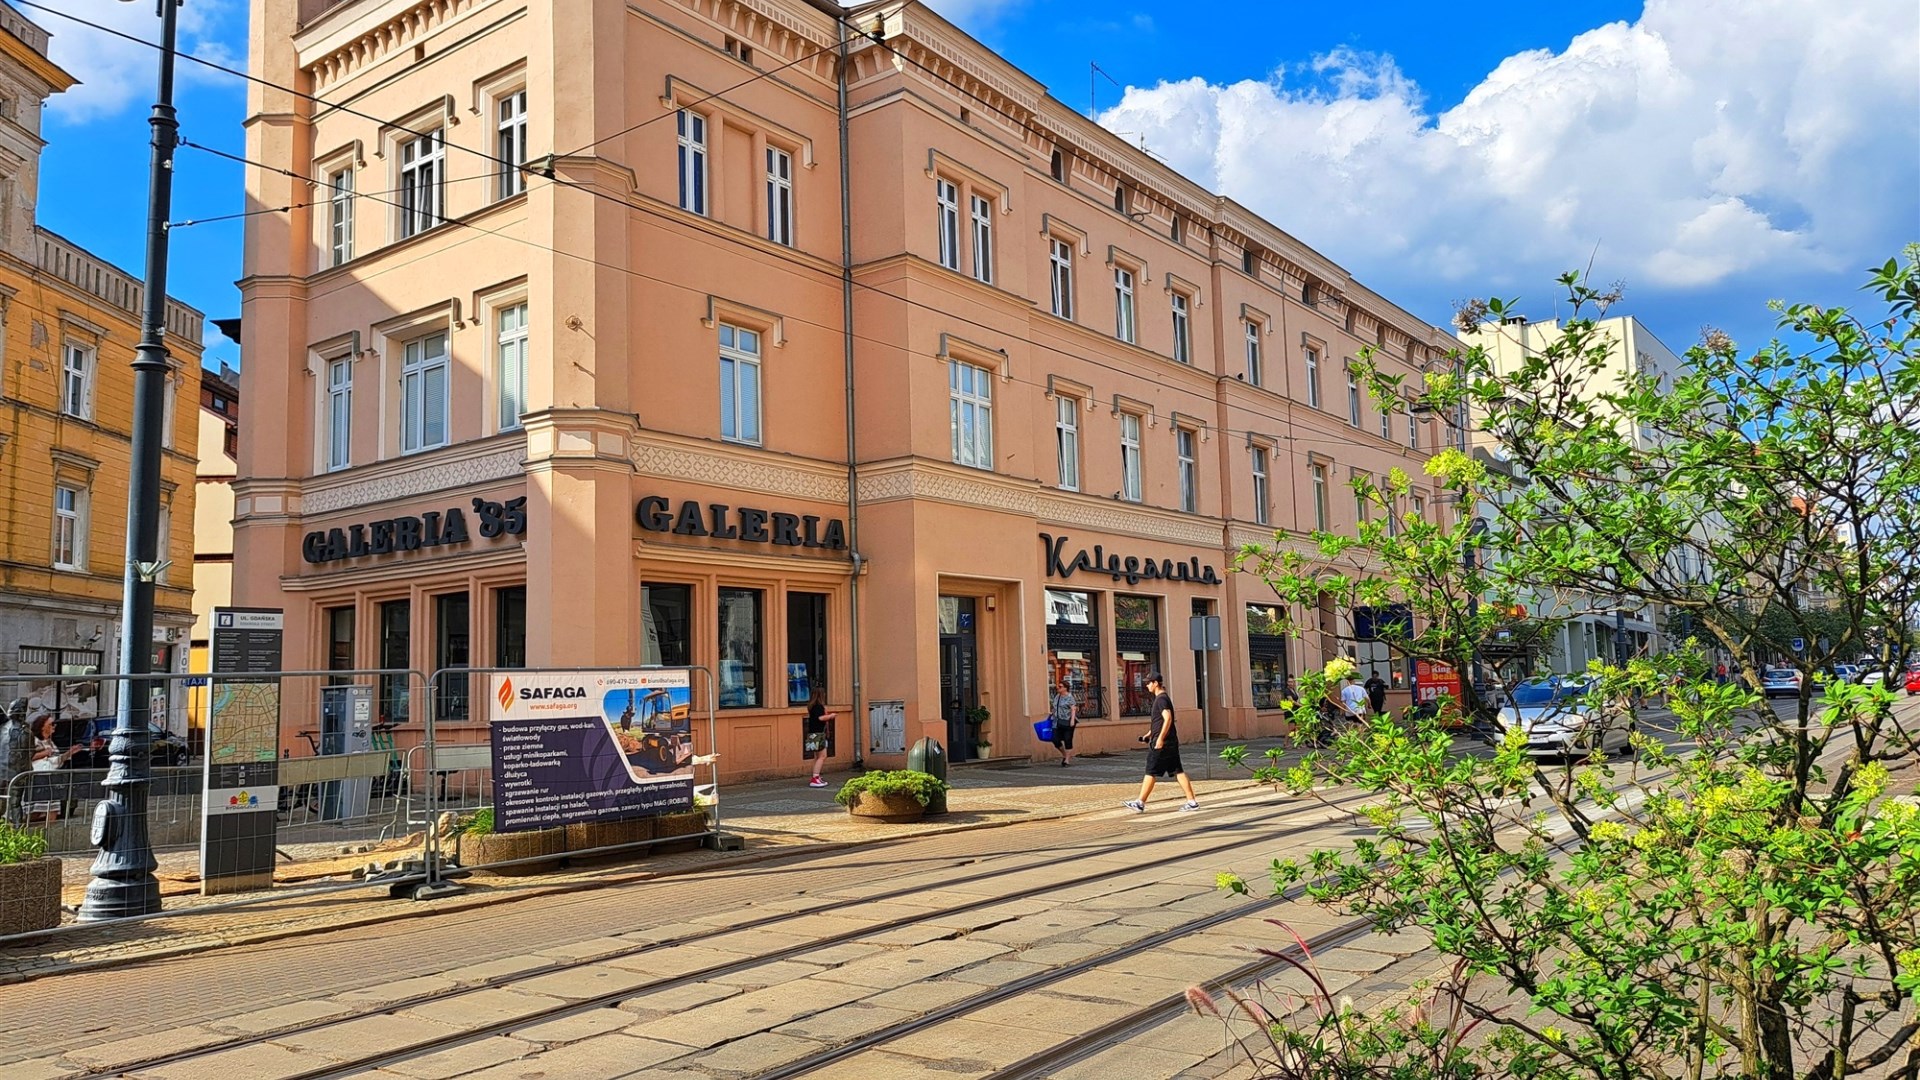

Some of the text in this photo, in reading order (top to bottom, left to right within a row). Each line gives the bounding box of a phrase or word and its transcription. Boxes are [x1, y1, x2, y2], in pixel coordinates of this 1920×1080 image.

[635, 495, 848, 550] GALERIA
[302, 496, 527, 564] GALERIA '85
[1039, 532, 1222, 585] Księgarnia
[187, 677, 206, 686] TAXI
[519, 686, 586, 700] SAFAGA
[529, 702, 578, 710] www.safaga.org
[502, 725, 528, 733] budowa
[529, 724, 557, 733] przyłączy
[502, 733, 541, 742] światłowody
[503, 752, 522, 761] usługi
[504, 771, 528, 779] dłużyca
[504, 779, 533, 789] wywrotki
[505, 787, 539, 798] zgrzewanie
[505, 797, 534, 806] okresowe
[535, 794, 559, 803] kontrole
[560, 792, 585, 800] instalacji
[505, 806, 534, 817] spawanie
[535, 804, 560, 812] instalacji
[505, 815, 541, 827] promienniki
[562, 808, 597, 819] nagrzewnice
[621, 803, 640, 811] zawory
[653, 799, 667, 807] MAG
